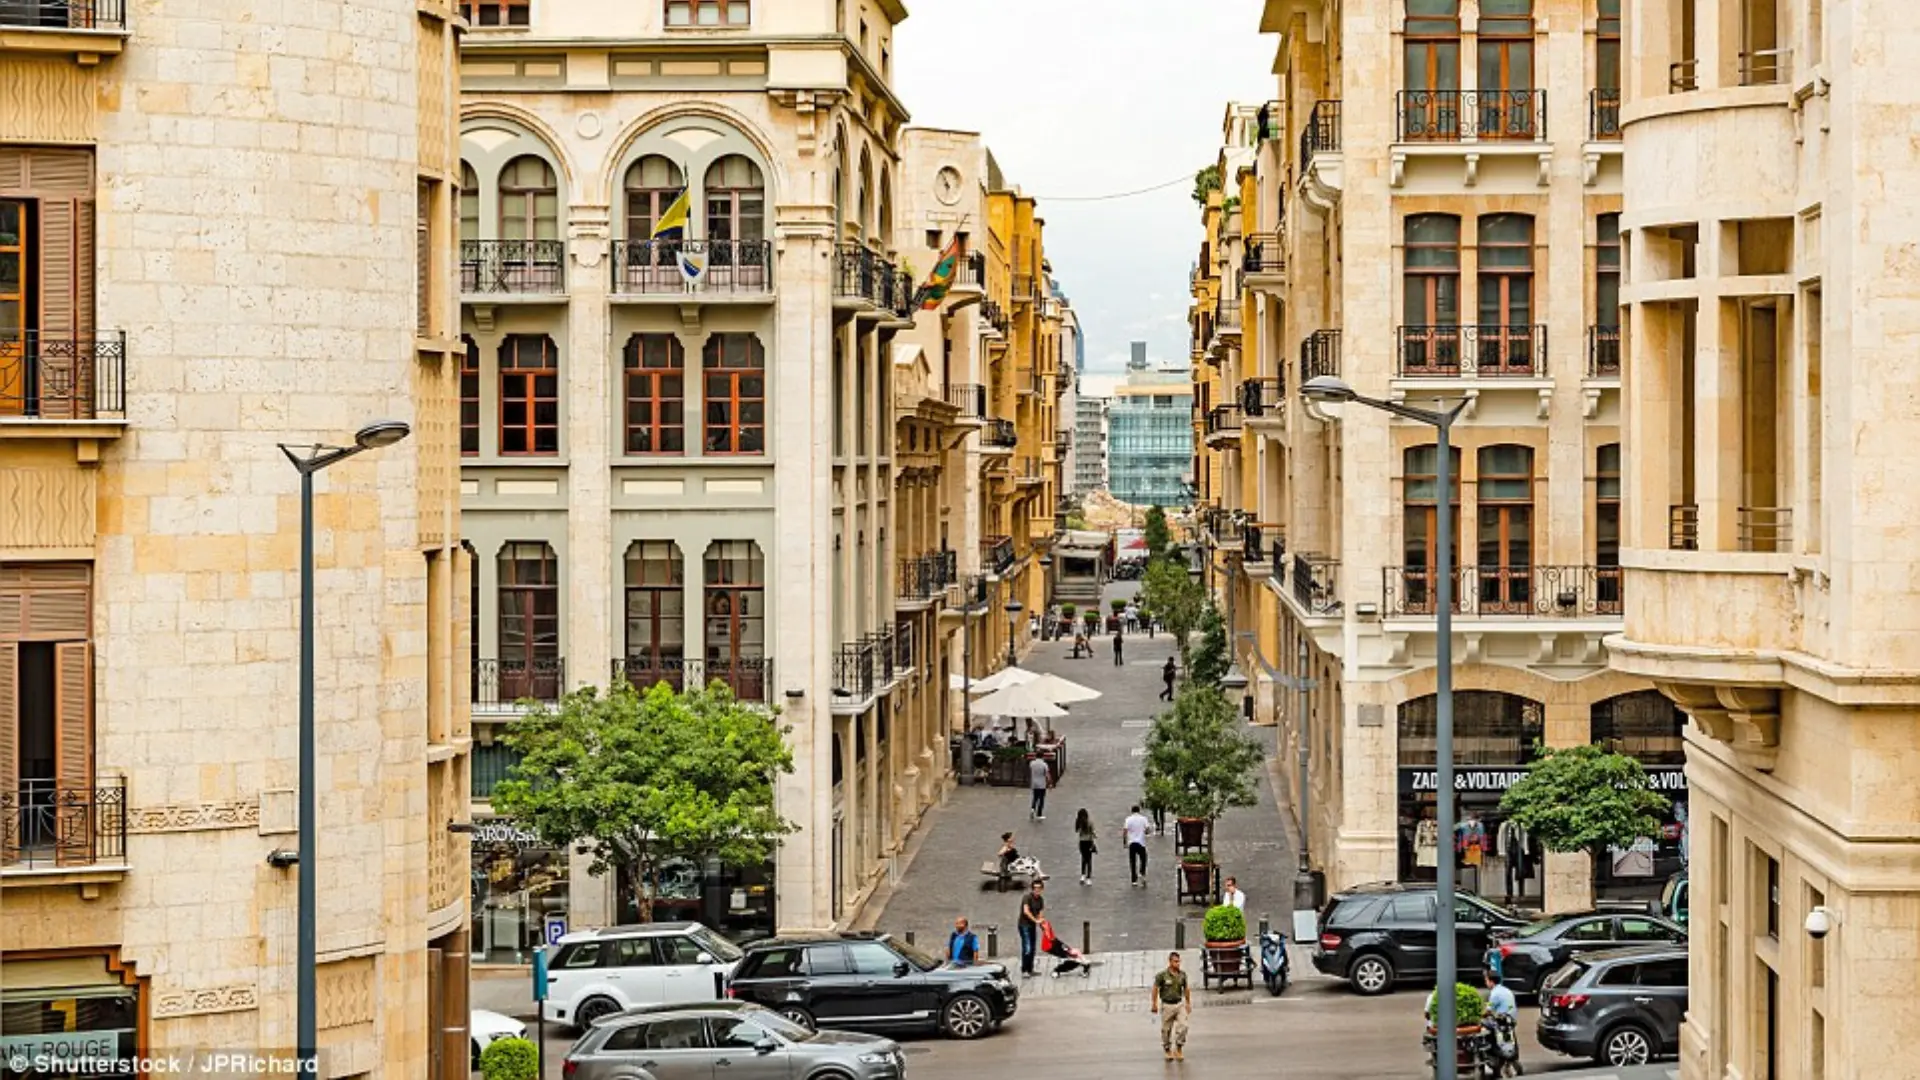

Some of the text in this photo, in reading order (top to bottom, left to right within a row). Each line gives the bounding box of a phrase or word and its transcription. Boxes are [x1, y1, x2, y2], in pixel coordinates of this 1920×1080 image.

[1412, 772, 1438, 789] ZAD
[1648, 772, 1687, 789] &VOL
[550, 924, 562, 942] P
[42, 1039, 111, 1059] ROUGE
